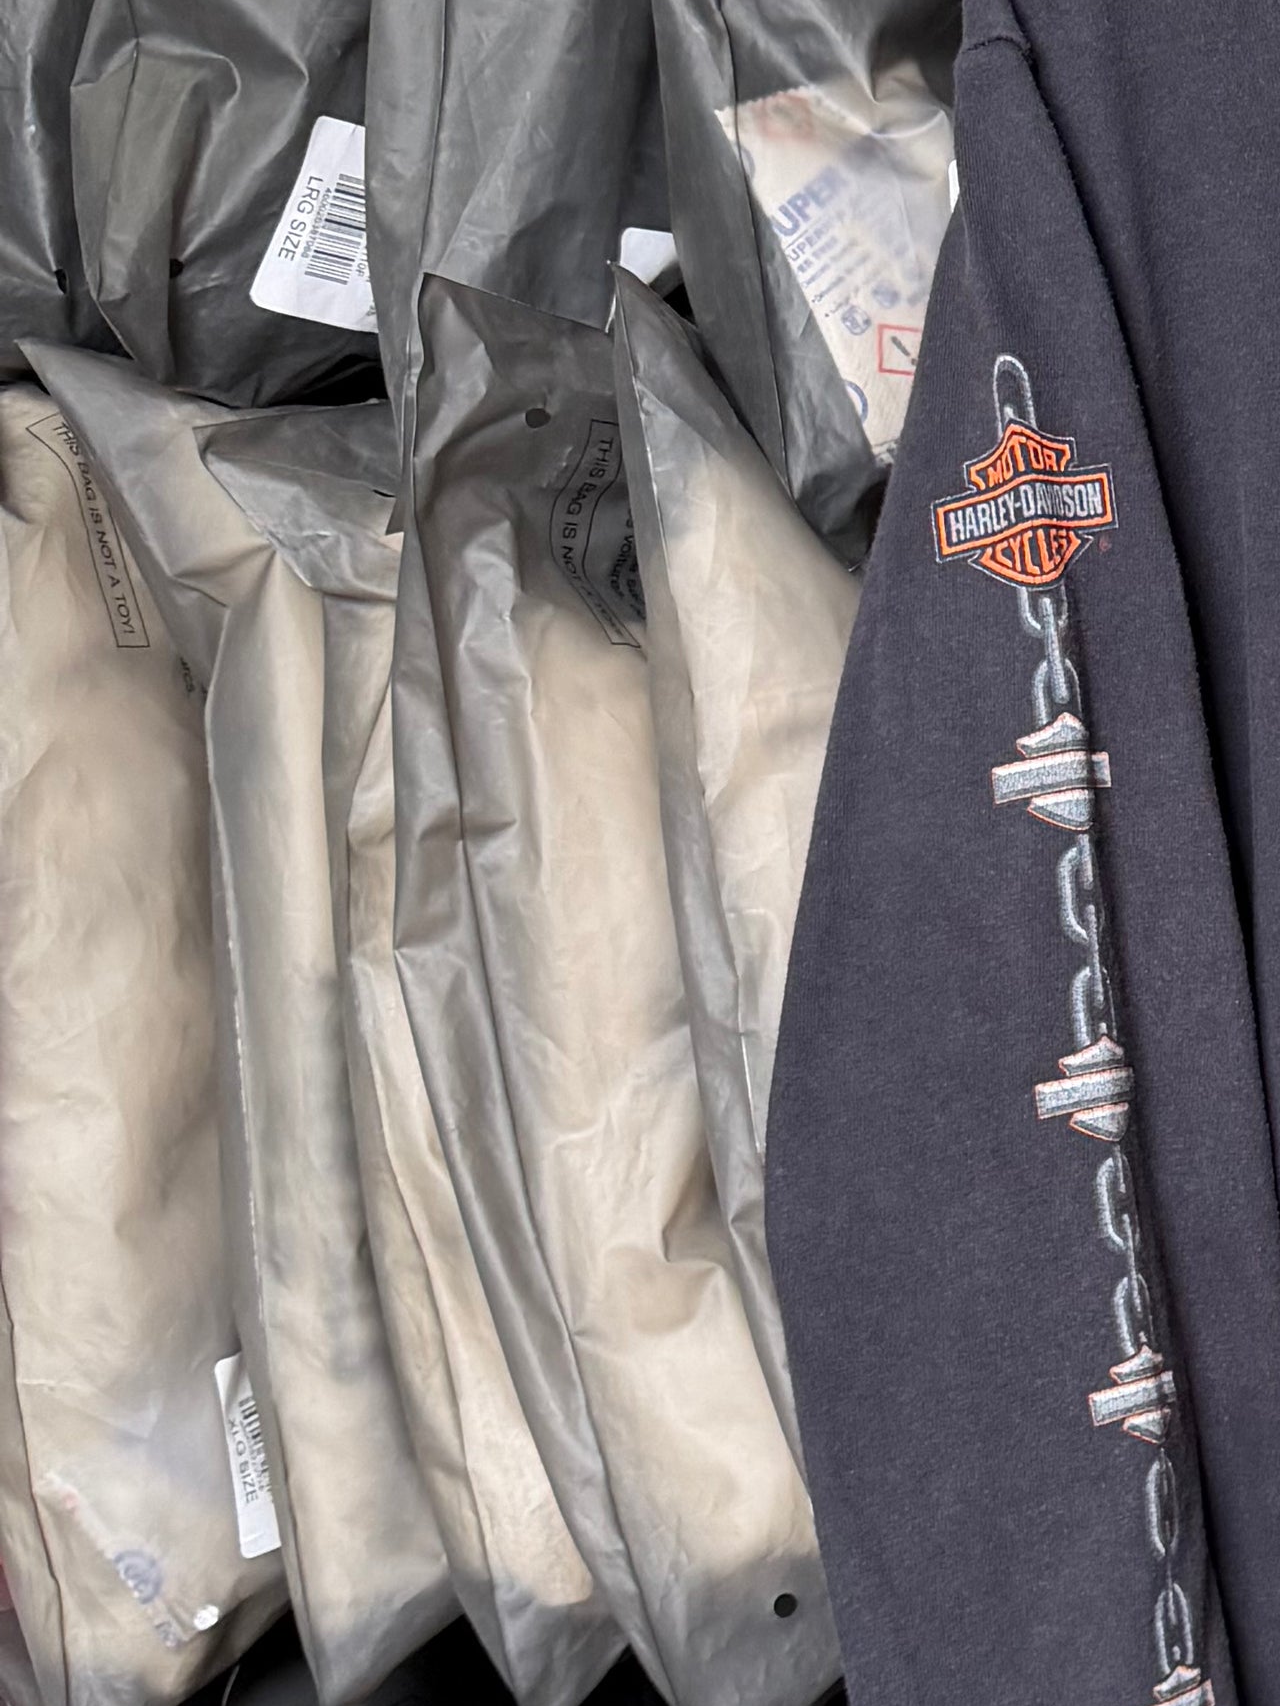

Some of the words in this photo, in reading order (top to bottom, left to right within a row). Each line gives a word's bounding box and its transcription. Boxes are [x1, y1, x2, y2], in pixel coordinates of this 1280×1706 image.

[297, 175, 323, 216] LRG
[278, 218, 306, 262] SIZE
[52, 421, 81, 457] THIS
[589, 437, 613, 478] THIS
[77, 461, 97, 502] BAG
[987, 437, 1058, 488] MOTOR
[88, 506, 102, 524] IS
[562, 523, 578, 540] IS
[949, 481, 1103, 544] HARLEY-DAVIDSON
[96, 529, 117, 570] NOT
[995, 529, 1068, 575] CYCLES
[107, 575, 121, 588] A
[113, 593, 135, 634] TOY!
[239, 1462, 259, 1503] SIZE
